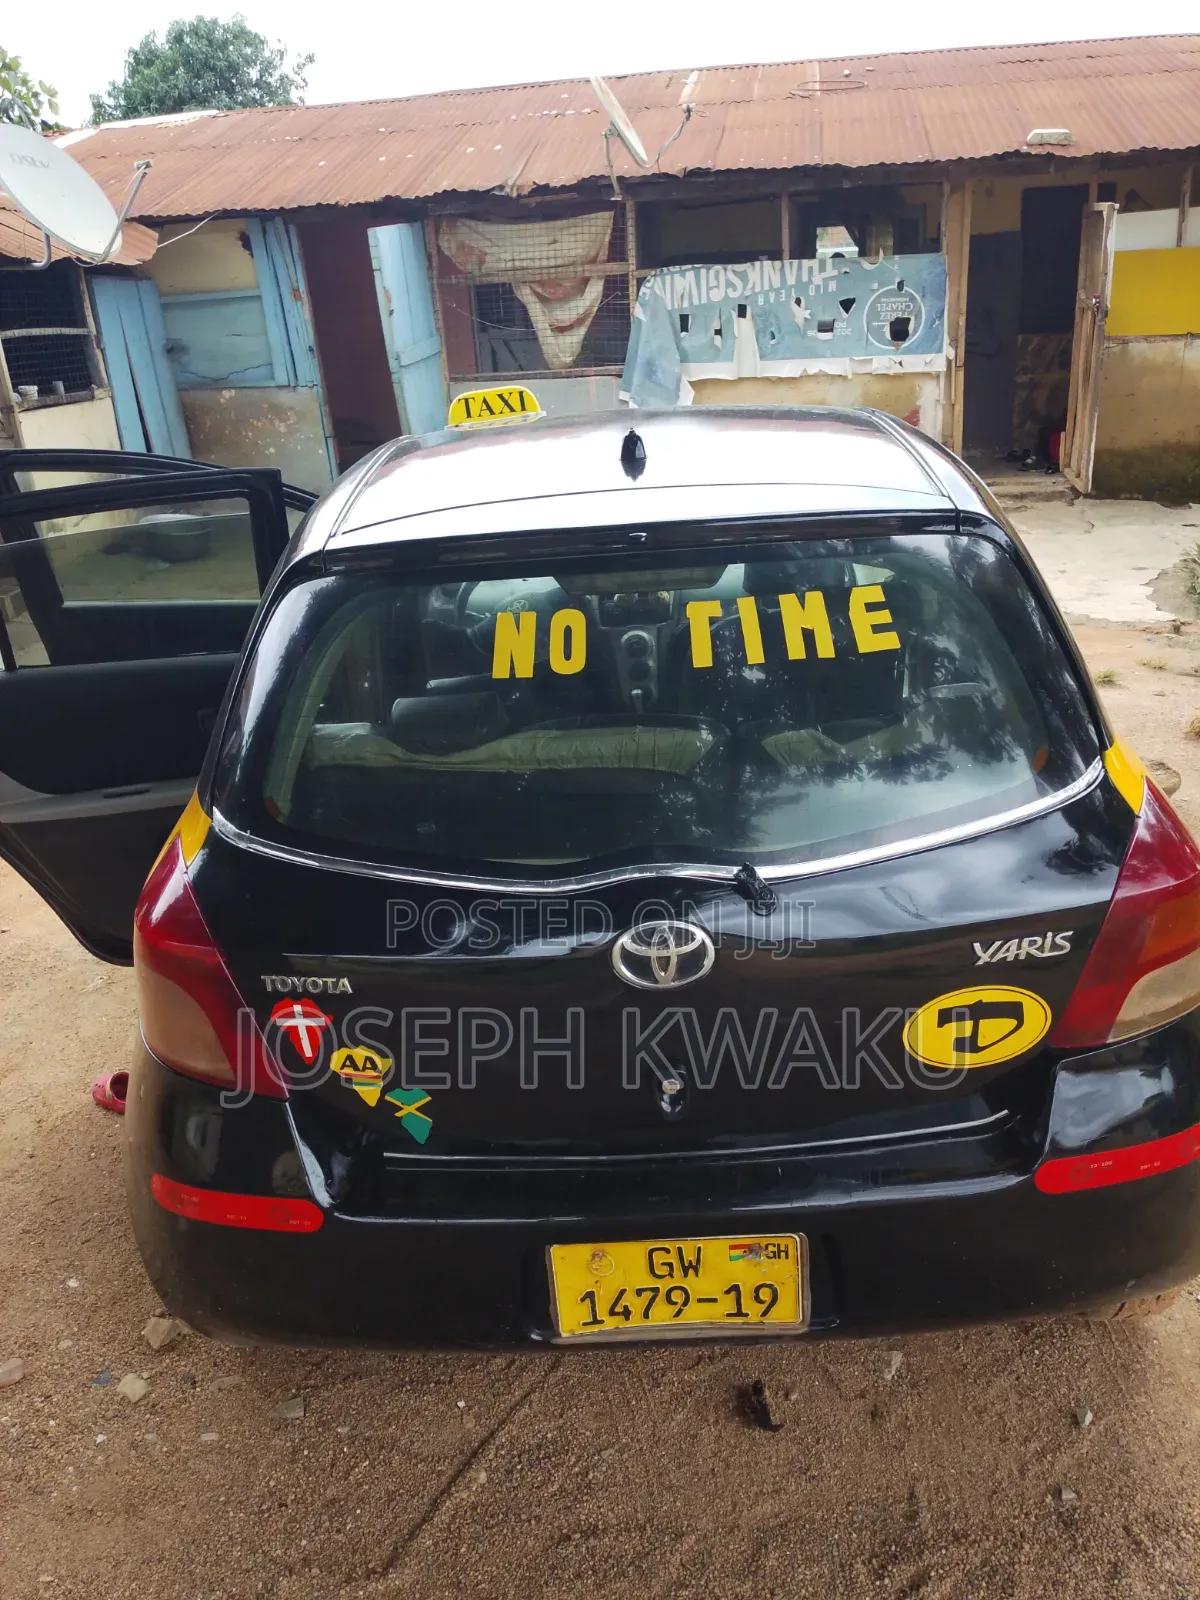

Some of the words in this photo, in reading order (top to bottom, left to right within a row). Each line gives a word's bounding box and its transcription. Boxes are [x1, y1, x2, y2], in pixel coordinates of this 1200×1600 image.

[876, 302, 914, 312] CHAPEL
[457, 391, 528, 418] TAXI
[492, 608, 587, 679] NO
[686, 585, 901, 668] TIME
[972, 931, 1075, 967] YARIS
[261, 975, 353, 995] TOYOTA
[339, 1053, 382, 1073] AA
[646, 1245, 703, 1280] GW
[764, 1242, 790, 1260] GH
[578, 1282, 780, 1327] 1479-19
